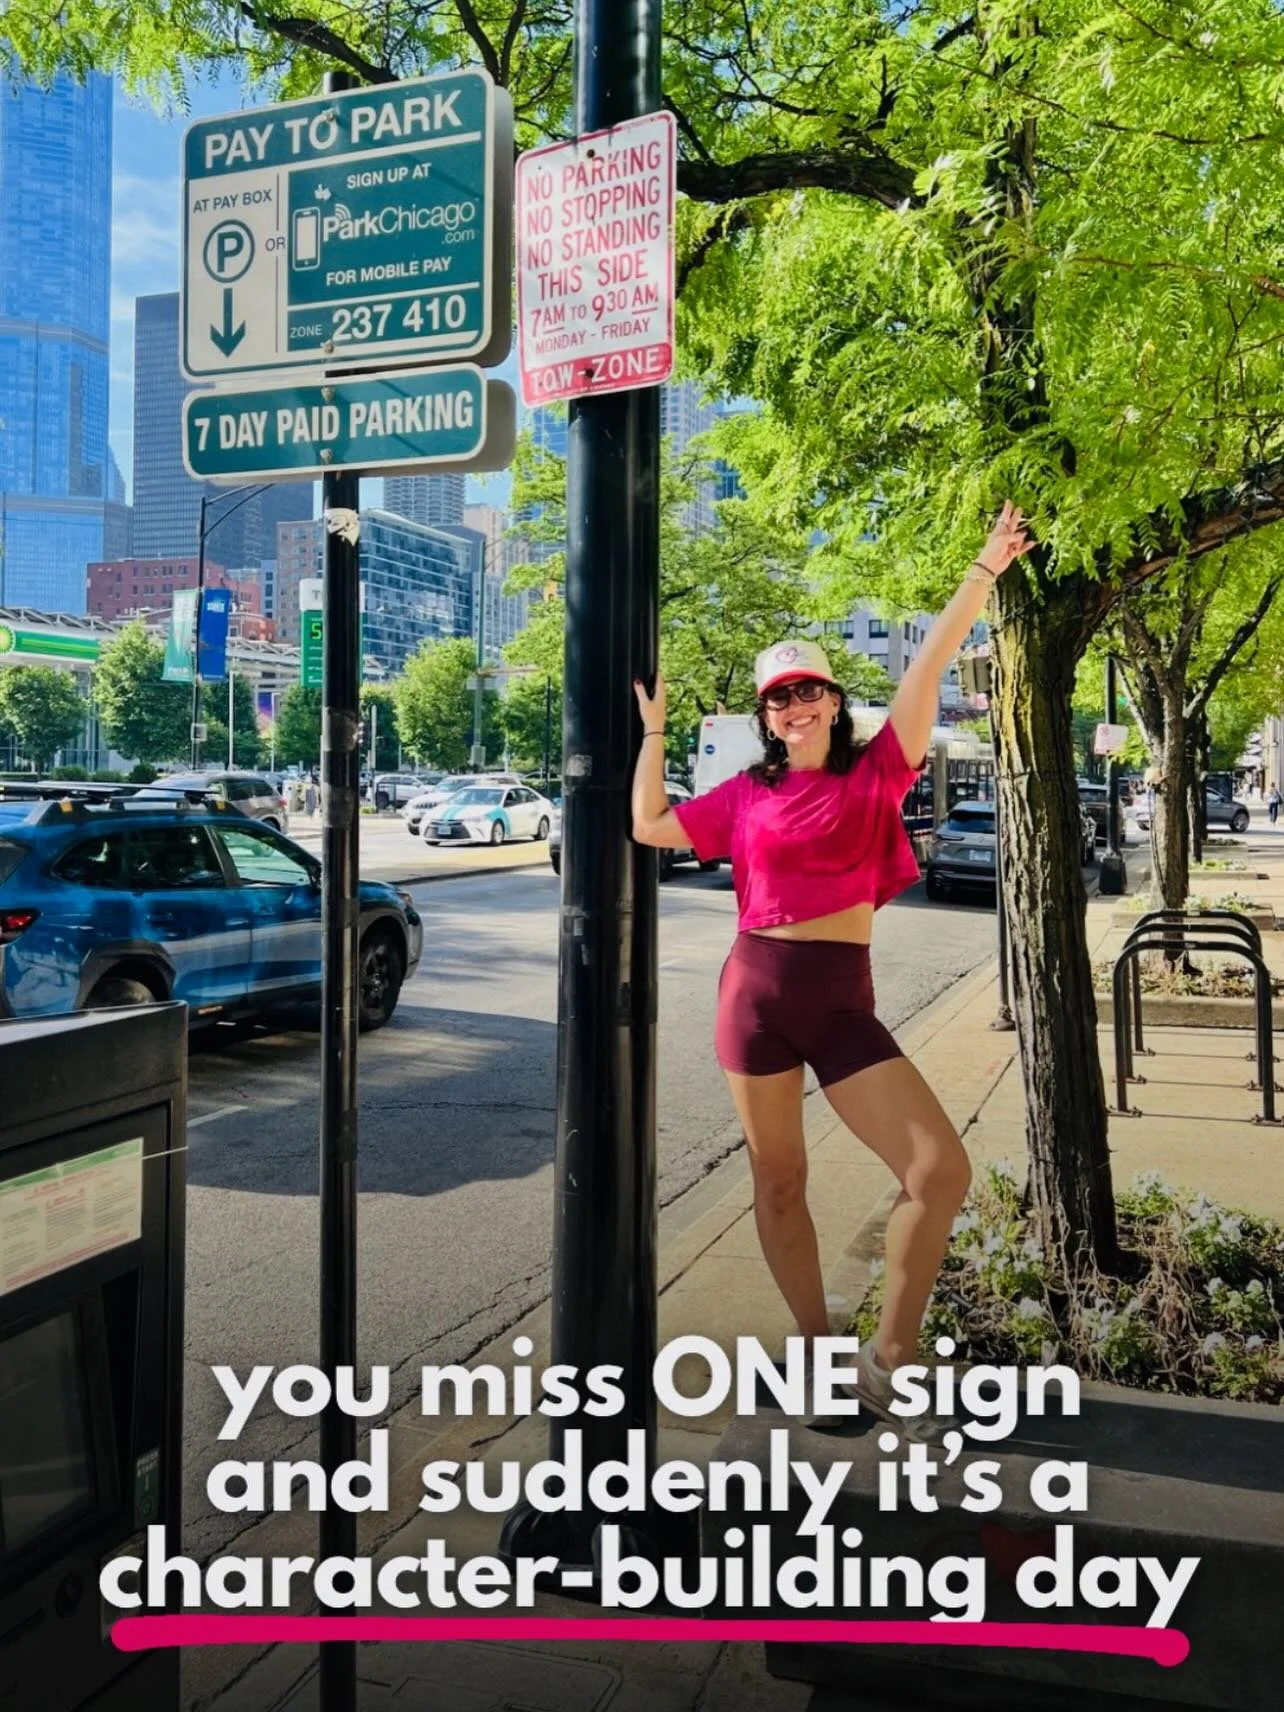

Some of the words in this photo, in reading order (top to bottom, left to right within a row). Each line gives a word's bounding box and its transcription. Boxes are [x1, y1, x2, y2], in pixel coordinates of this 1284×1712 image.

[205, 124, 273, 168] PAY
[284, 112, 338, 154] TO
[351, 90, 462, 143] PARK
[346, 171, 384, 189] SIGN
[387, 167, 408, 183] UP
[411, 163, 432, 178] AT
[527, 173, 553, 203] NO
[562, 141, 661, 194] PARKING
[193, 199, 211, 214] AT
[213, 194, 239, 210] PAY
[244, 188, 272, 207] BOX
[322, 201, 476, 242] ParkChicago
[527, 206, 553, 237] NO
[561, 175, 661, 227] STOPPING
[265, 236, 286, 252] OR
[442, 228, 475, 244] .com
[527, 238, 553, 270] NO
[561, 211, 661, 261] STANDING
[326, 268, 357, 287] FOR
[360, 260, 419, 282] MOBILE
[423, 256, 452, 275] PAY
[538, 265, 582, 301] THIS
[597, 248, 648, 287] SIDE
[290, 324, 323, 339] ZONE
[331, 303, 393, 342] 237
[402, 294, 466, 333] 410
[570, 304, 587, 321] TO
[631, 282, 659, 307] AM
[535, 330, 587, 354] MONDAY
[601, 318, 650, 341] FRIDAY
[194, 417, 211, 452] 7
[219, 410, 268, 450] DAY
[277, 404, 340, 445] PAID
[350, 390, 473, 439] PARKING
